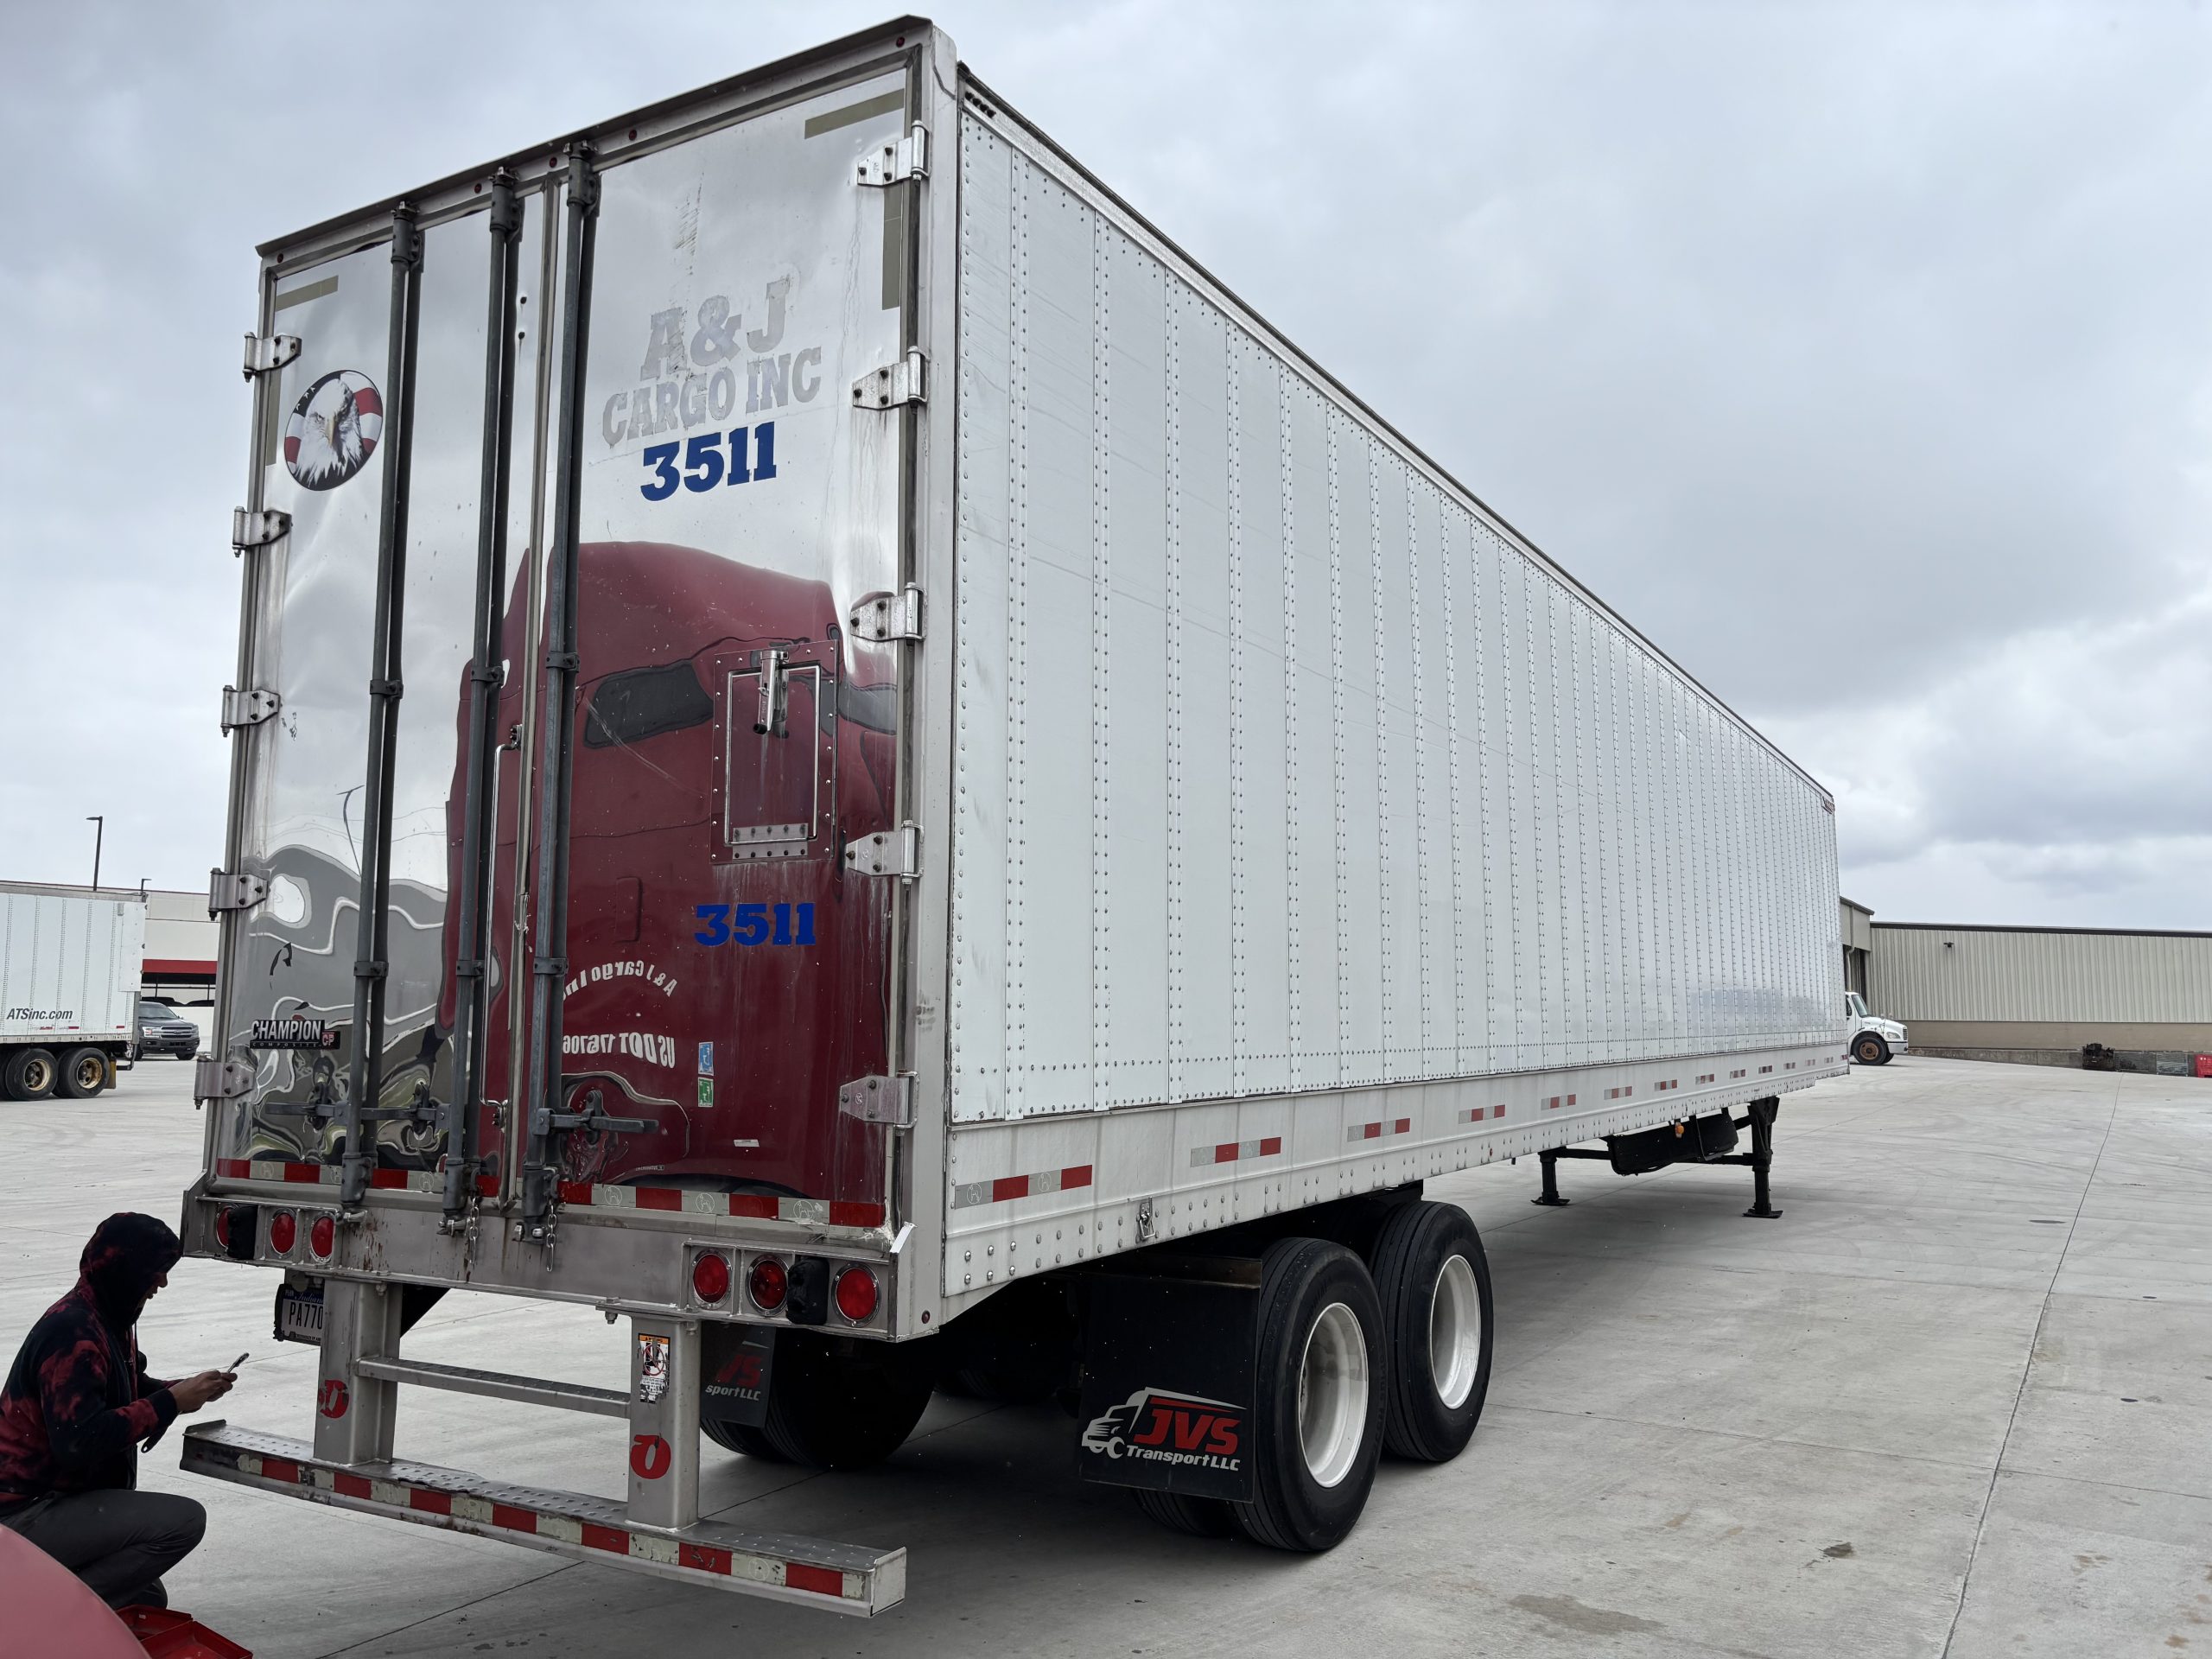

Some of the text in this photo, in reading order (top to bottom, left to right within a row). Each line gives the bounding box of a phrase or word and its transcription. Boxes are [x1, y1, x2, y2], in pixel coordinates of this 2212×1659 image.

[602, 346, 822, 448] CARGO INC
[640, 421, 777, 501] 3511
[694, 902, 817, 946] 3511
[6, 1007, 73, 1020] ATSinc.com
[251, 1020, 321, 1041] CHAMPION
[289, 1301, 324, 1330] PA770
[1133, 1408, 1241, 1455] JVS
